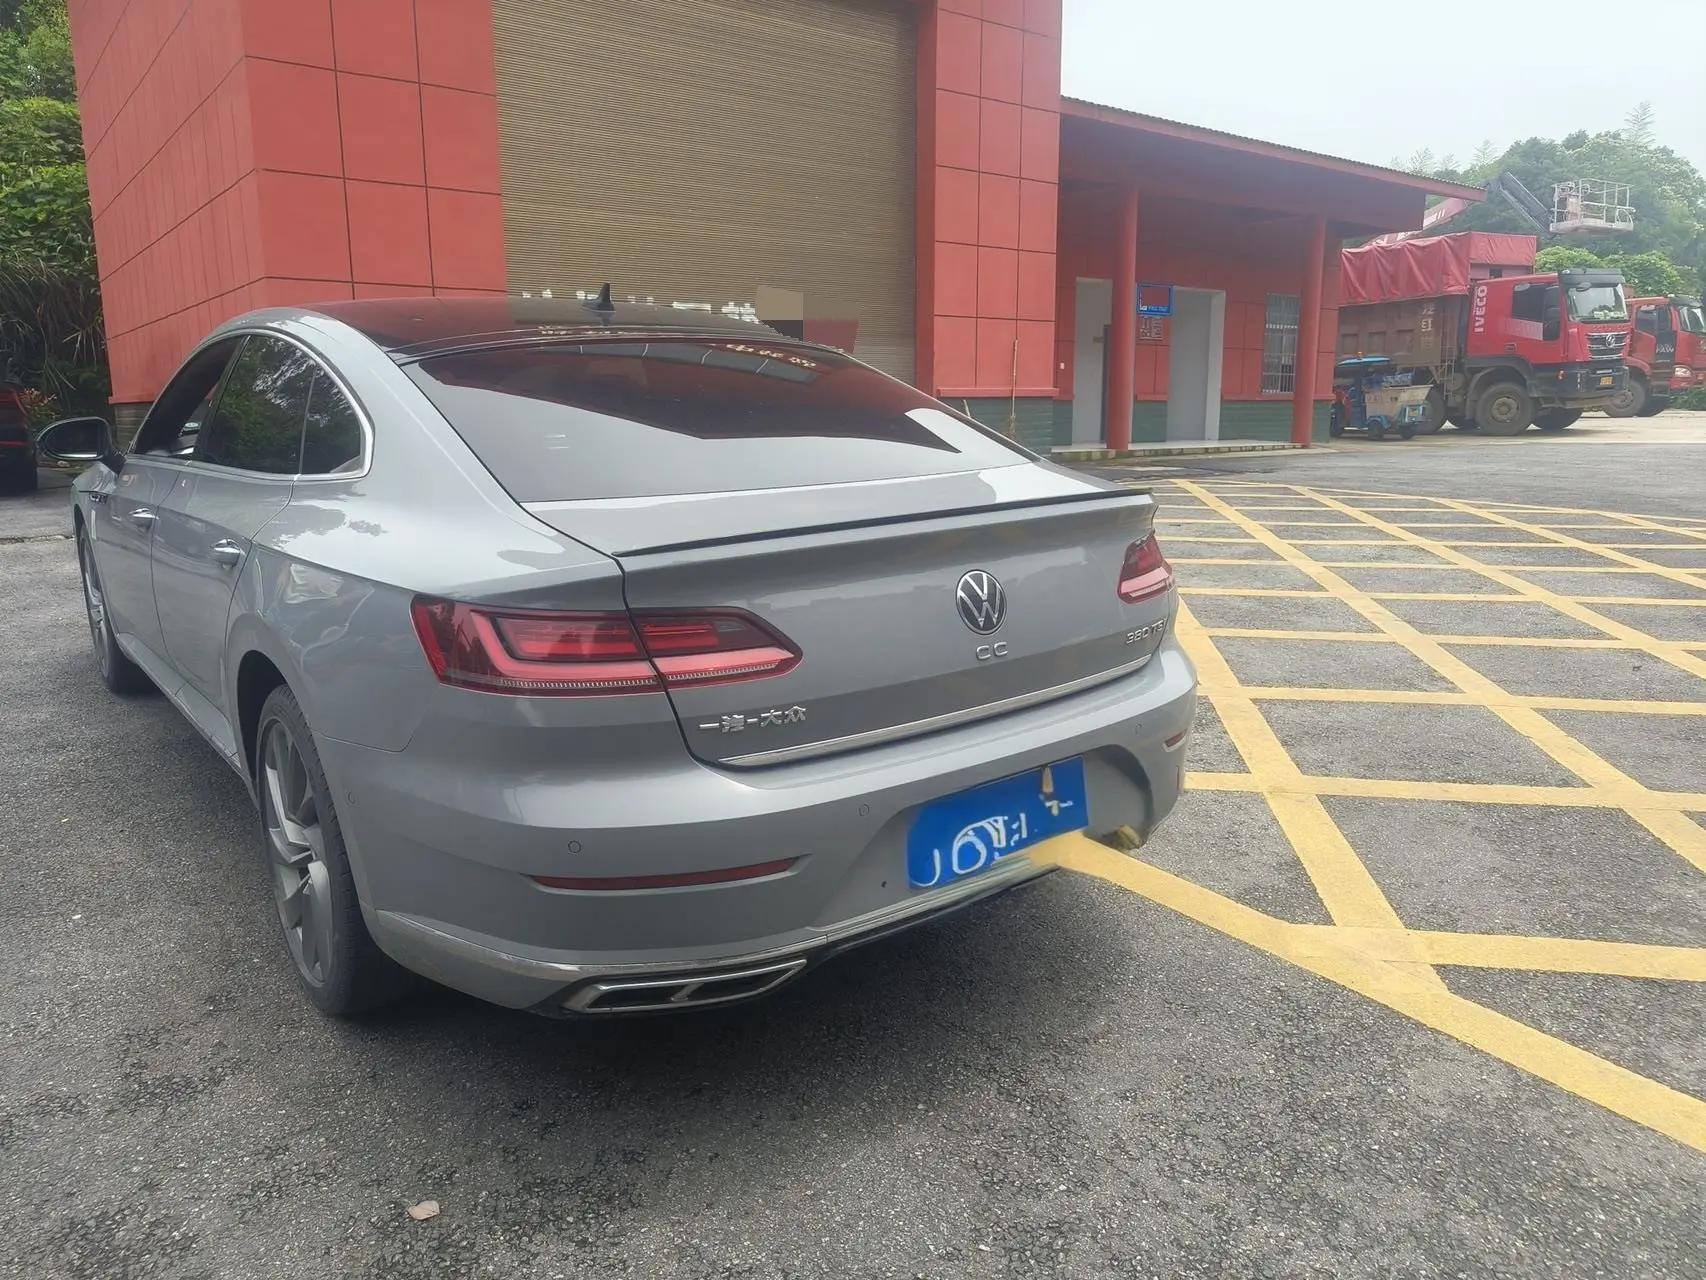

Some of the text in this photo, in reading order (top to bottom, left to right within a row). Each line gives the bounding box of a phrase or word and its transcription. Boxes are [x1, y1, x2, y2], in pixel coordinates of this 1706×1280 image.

[1473, 285, 1488, 333] IVECO
[1126, 626, 1150, 645] 380
[976, 641, 1009, 660] CC
